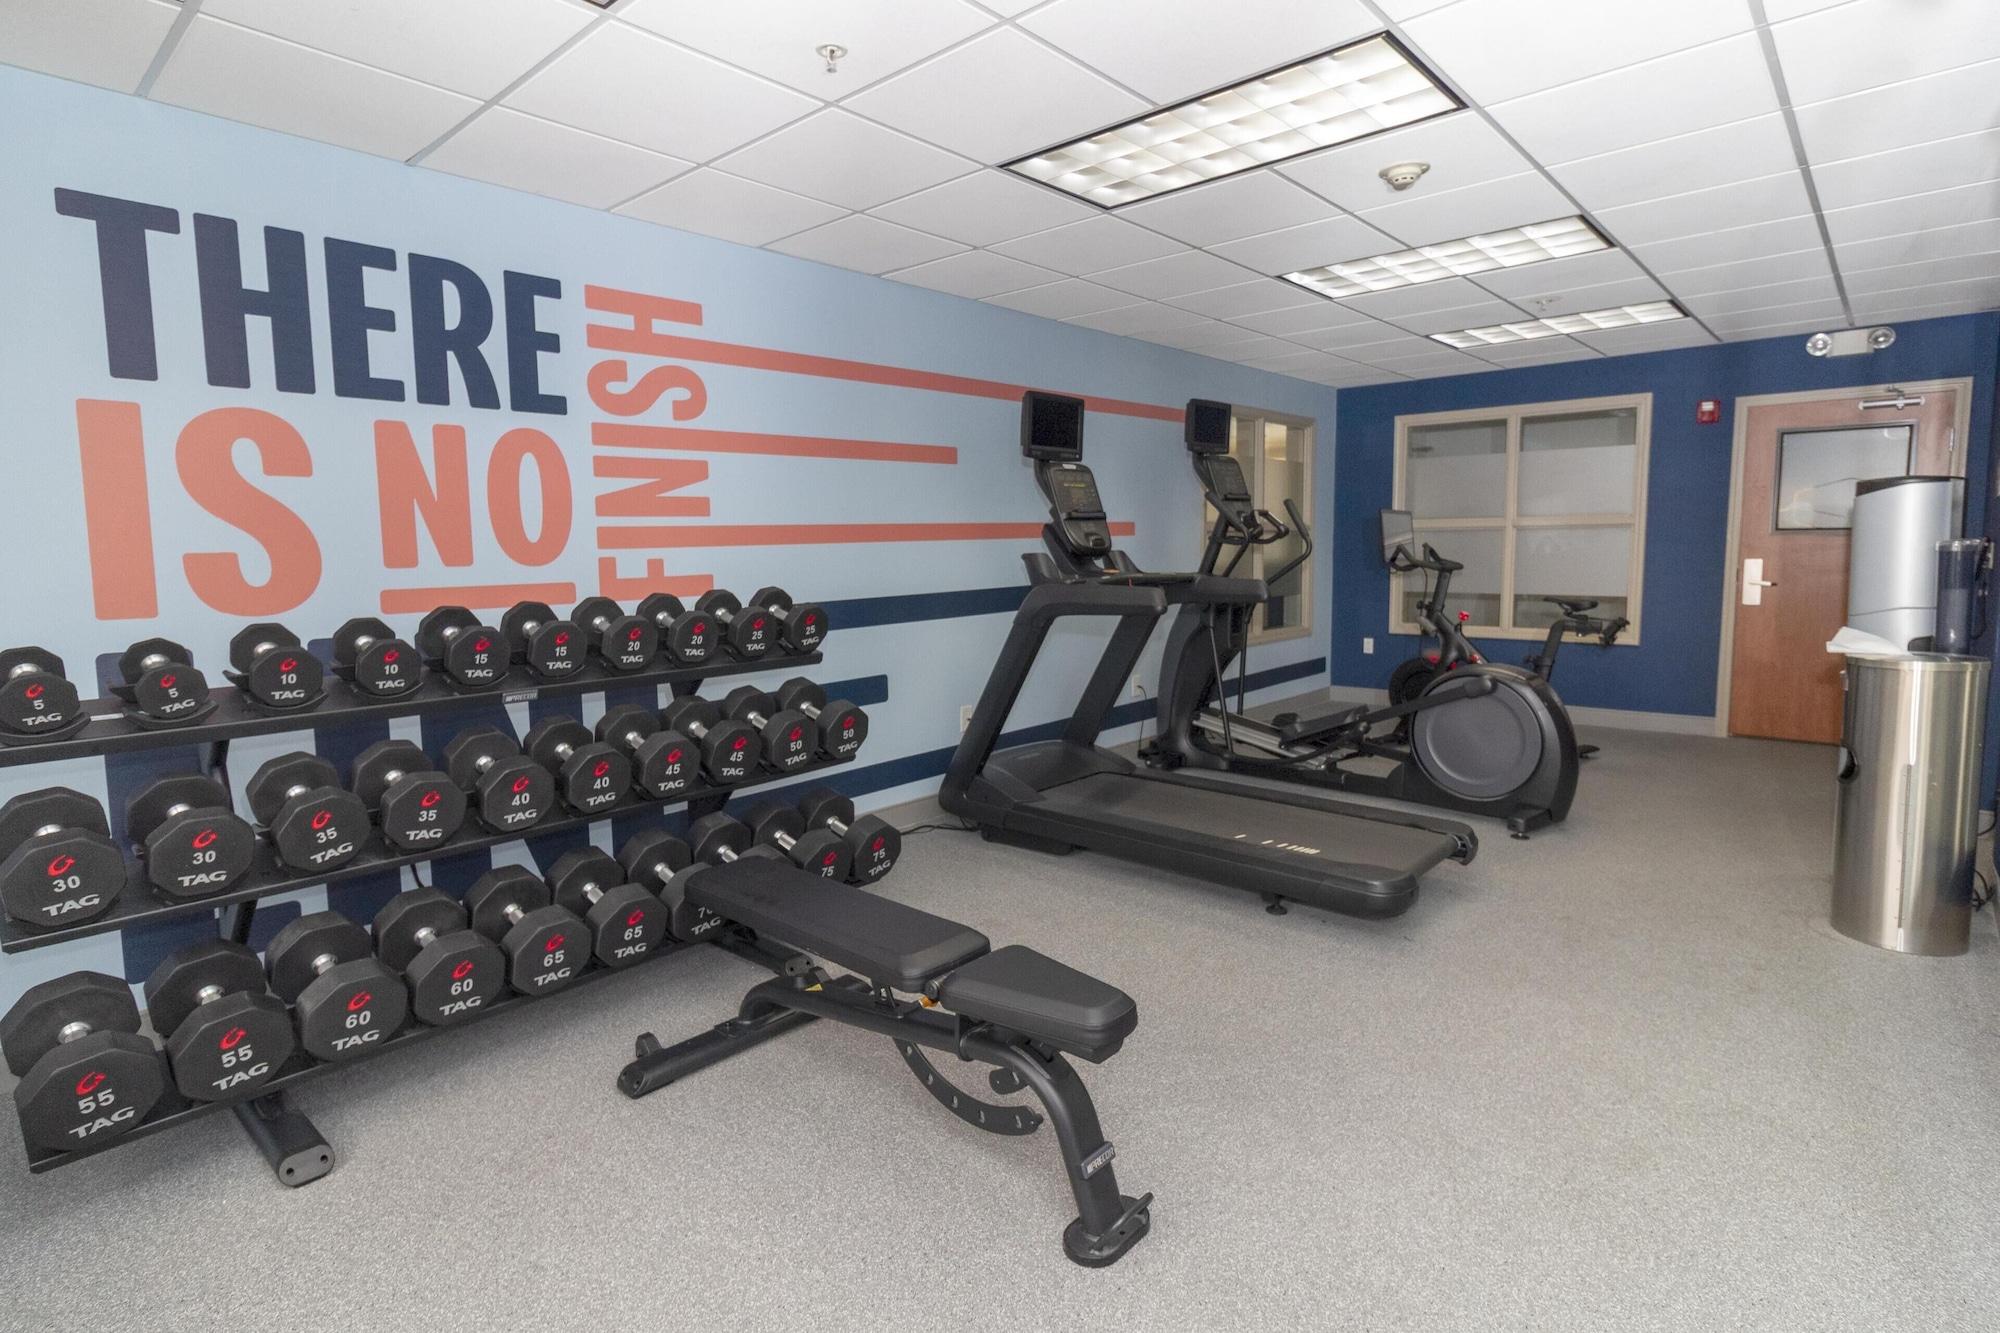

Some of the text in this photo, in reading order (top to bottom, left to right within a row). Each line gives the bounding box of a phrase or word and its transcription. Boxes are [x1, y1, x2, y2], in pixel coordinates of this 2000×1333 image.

[54, 187, 568, 416] THERE
[584, 284, 714, 601] FINISH
[76, 398, 573, 621] IS NO
[751, 630, 763, 640] 25
[805, 624, 816, 635] 25
[627, 640, 641, 651] 20
[691, 635, 703, 645] 20
[746, 643, 765, 651] TAG
[801, 636, 819, 646] TAG
[555, 646, 568, 657] 15
[684, 648, 705, 656] TAG
[474, 653, 489, 665] 15
[546, 660, 572, 670] TAG
[620, 654, 644, 664] TAG
[384, 664, 399, 675] 10
[465, 668, 492, 678] TAG
[280, 673, 297, 685] 10
[376, 679, 405, 689] TAG
[168, 687, 179, 698] 5
[271, 689, 304, 700] TAG
[33, 699, 45, 711] 5
[161, 698, 195, 713] TAG
[22, 712, 62, 726] TAG
[843, 728, 854, 740] 50
[790, 740, 803, 752] 50
[838, 740, 858, 753] TAG
[729, 751, 744, 762] 45
[785, 752, 807, 766] TAG
[665, 763, 681, 776] 45
[721, 767, 744, 776] TAG
[593, 776, 610, 790] 40
[658, 779, 684, 791] TAG
[511, 792, 530, 806] 40
[587, 791, 615, 806] TAG
[418, 809, 438, 822] 35
[504, 808, 536, 824] TAG
[315, 826, 338, 844] 35
[406, 828, 442, 841] TAG
[192, 850, 217, 865] 30
[310, 842, 352, 864] TAG
[873, 848, 886, 862] 75
[821, 865, 835, 877] 75
[868, 860, 891, 876] TAG
[53, 875, 80, 893] 30
[178, 870, 226, 887] TAG
[42, 893, 100, 917] TAG
[623, 925, 643, 941] 65
[692, 919, 721, 935] TAG
[615, 942, 646, 959] TAG
[543, 949, 565, 967] 65
[534, 967, 570, 986] TAG
[450, 978, 474, 996] 60
[440, 995, 481, 1016] TAG
[345, 1010, 371, 1029] 60
[332, 1029, 379, 1051] TAG
[222, 1044, 252, 1068] 55
[213, 1062, 268, 1091] TAG
[79, 1088, 114, 1114] 55
[69, 1106, 134, 1139] TAG
